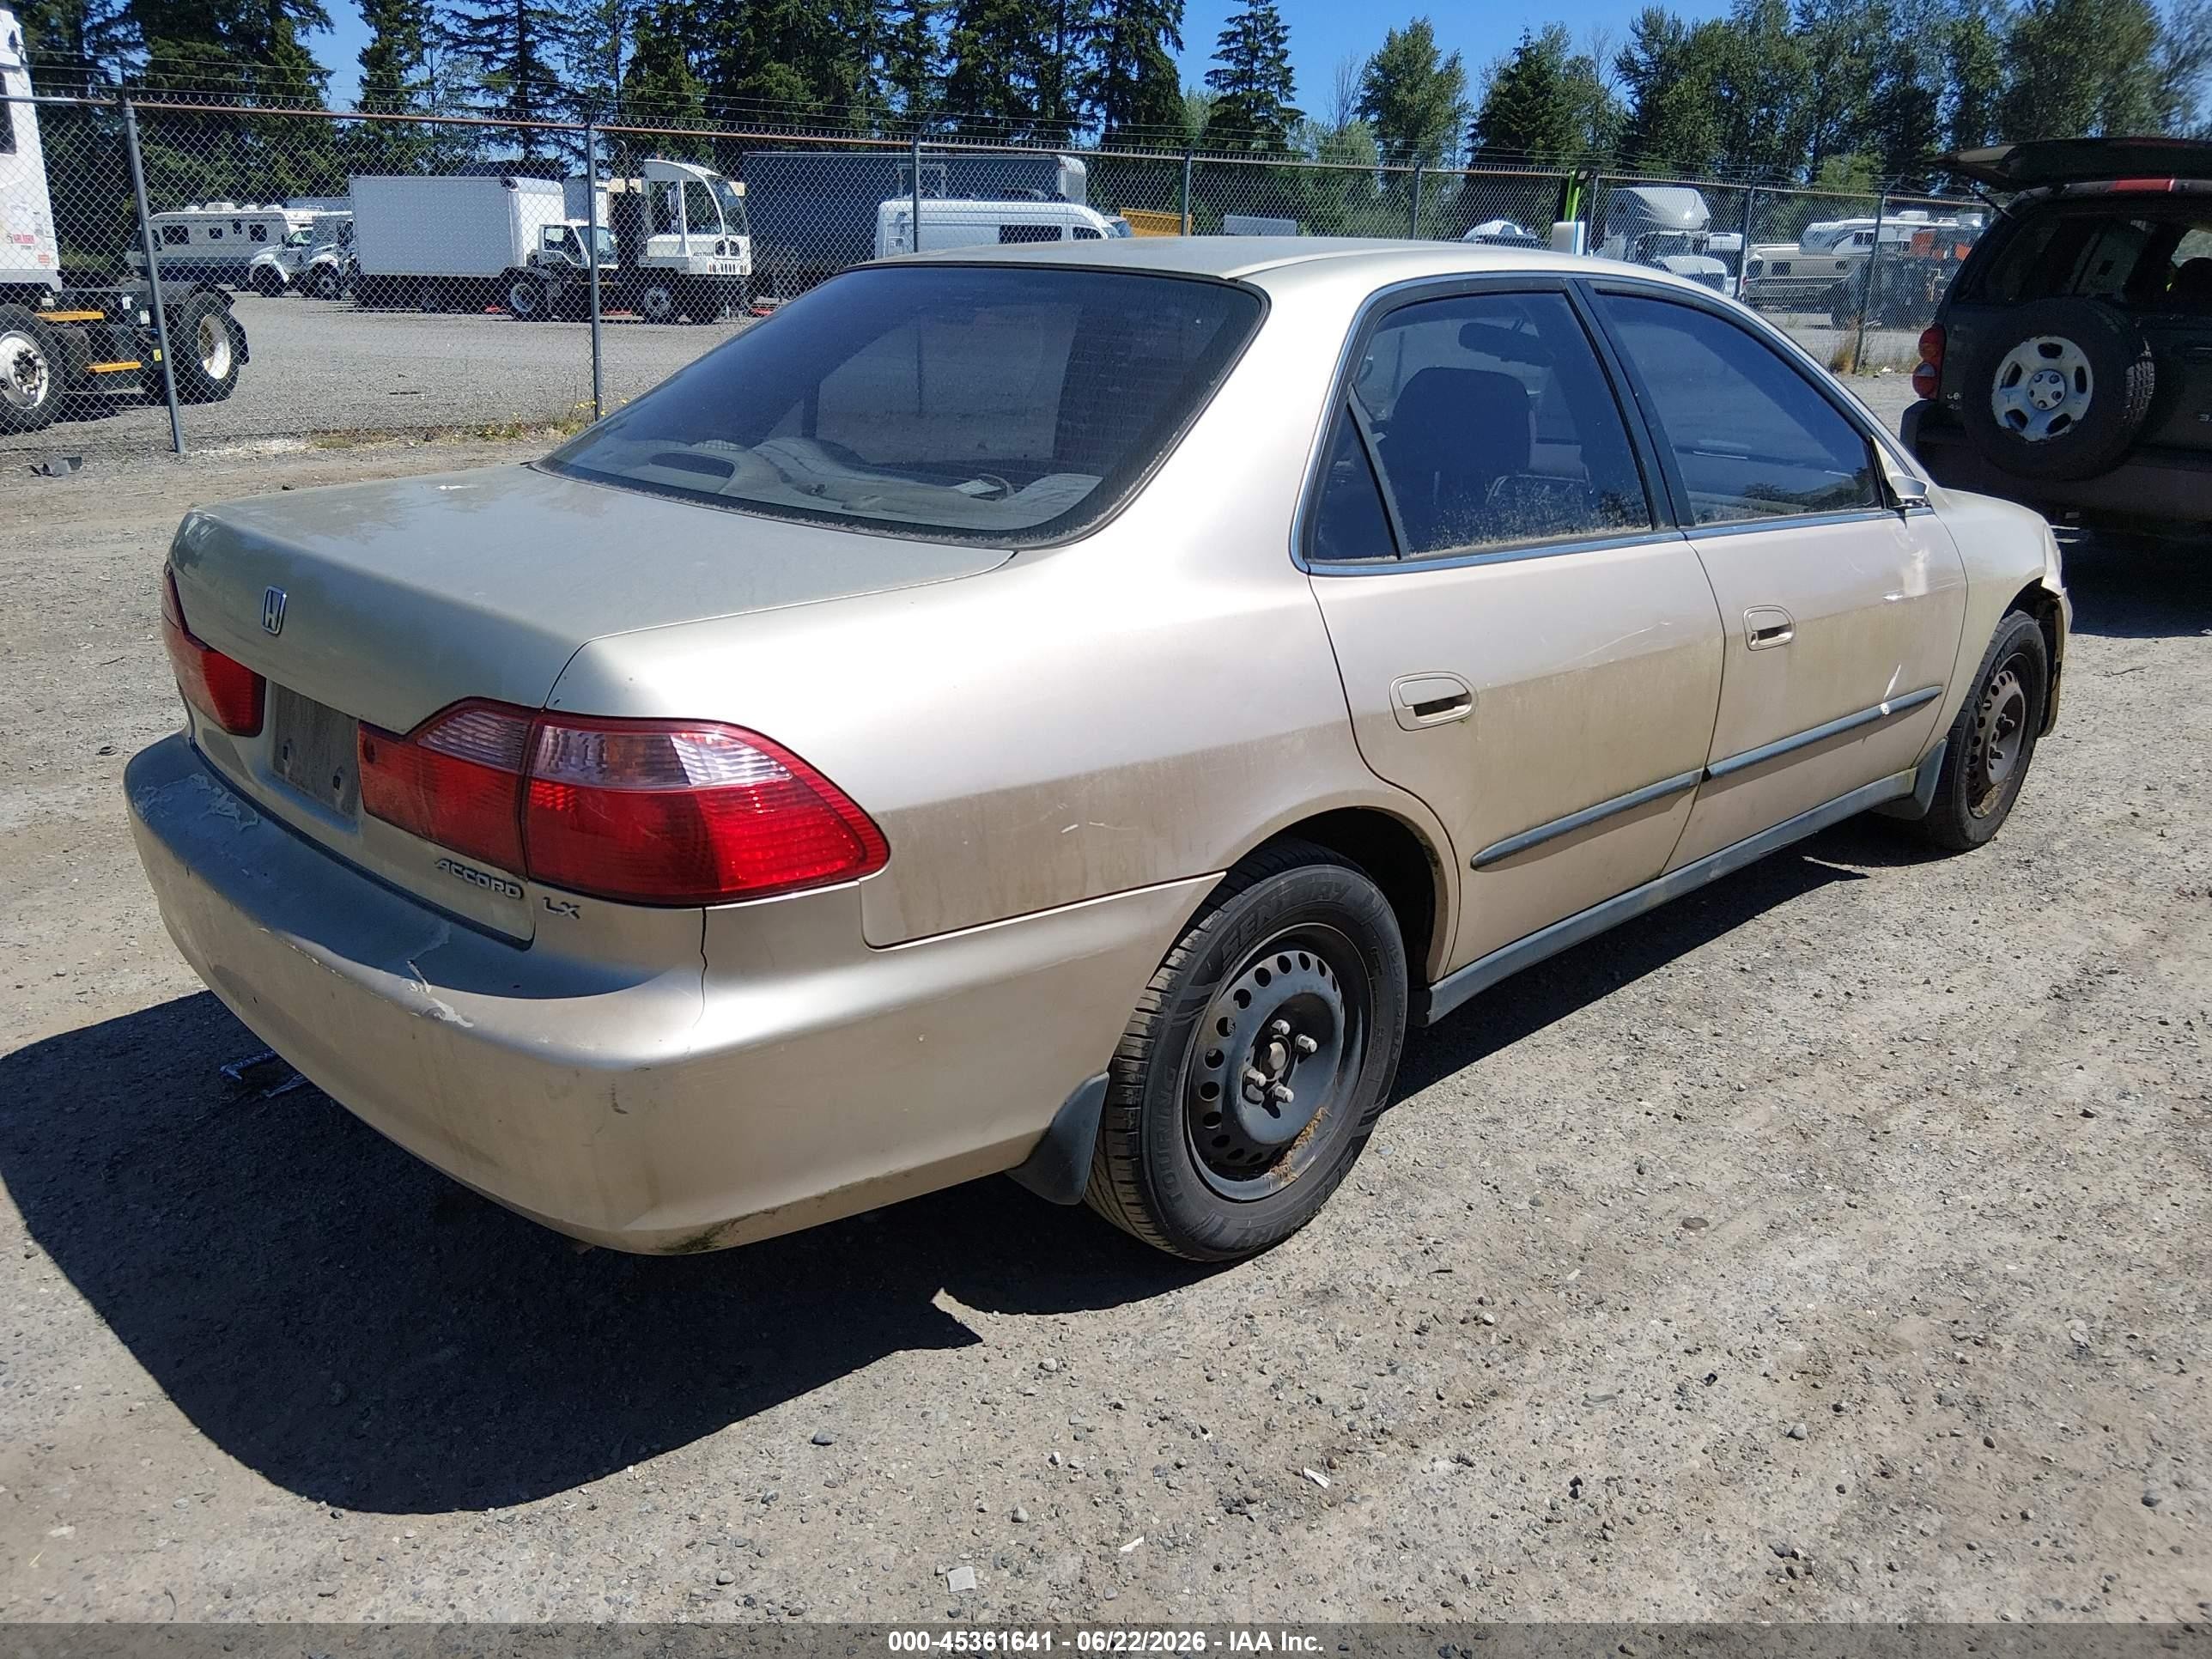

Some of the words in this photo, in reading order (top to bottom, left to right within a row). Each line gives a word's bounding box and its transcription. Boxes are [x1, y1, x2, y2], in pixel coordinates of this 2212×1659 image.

[434, 859, 523, 899] ACCORD
[543, 896, 580, 920] LX
[1155, 1065, 1183, 1207] TOURING
